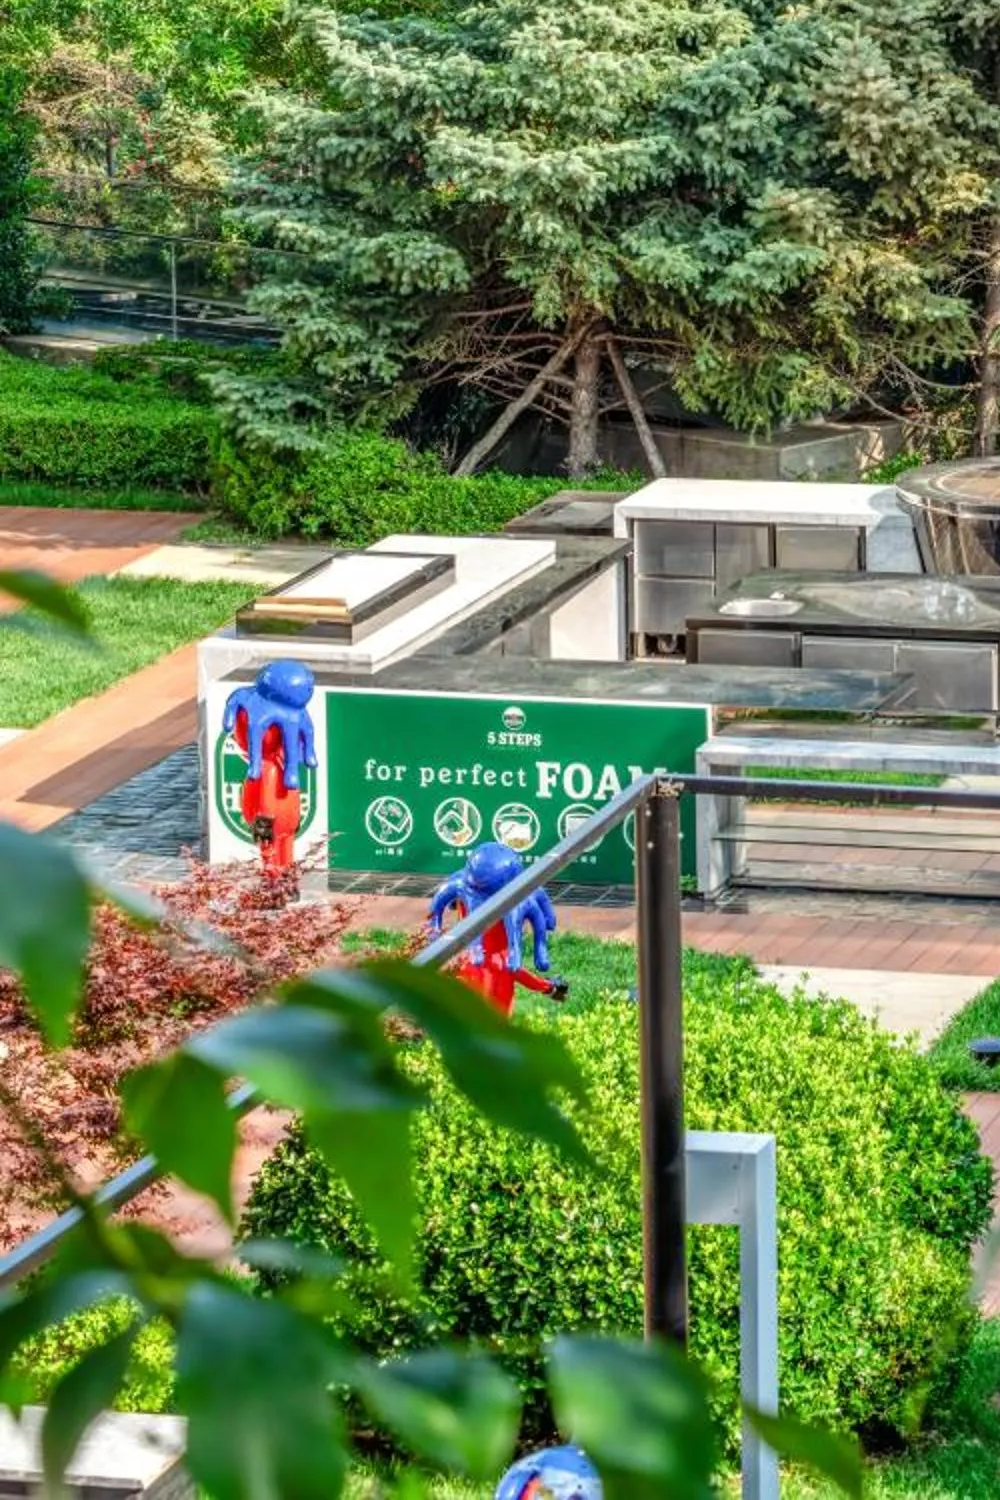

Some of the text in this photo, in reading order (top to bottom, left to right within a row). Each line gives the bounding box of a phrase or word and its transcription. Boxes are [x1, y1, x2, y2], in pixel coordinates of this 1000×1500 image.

[498, 731, 542, 747] STEPS
[364, 759, 667, 801] for perfect FOA
